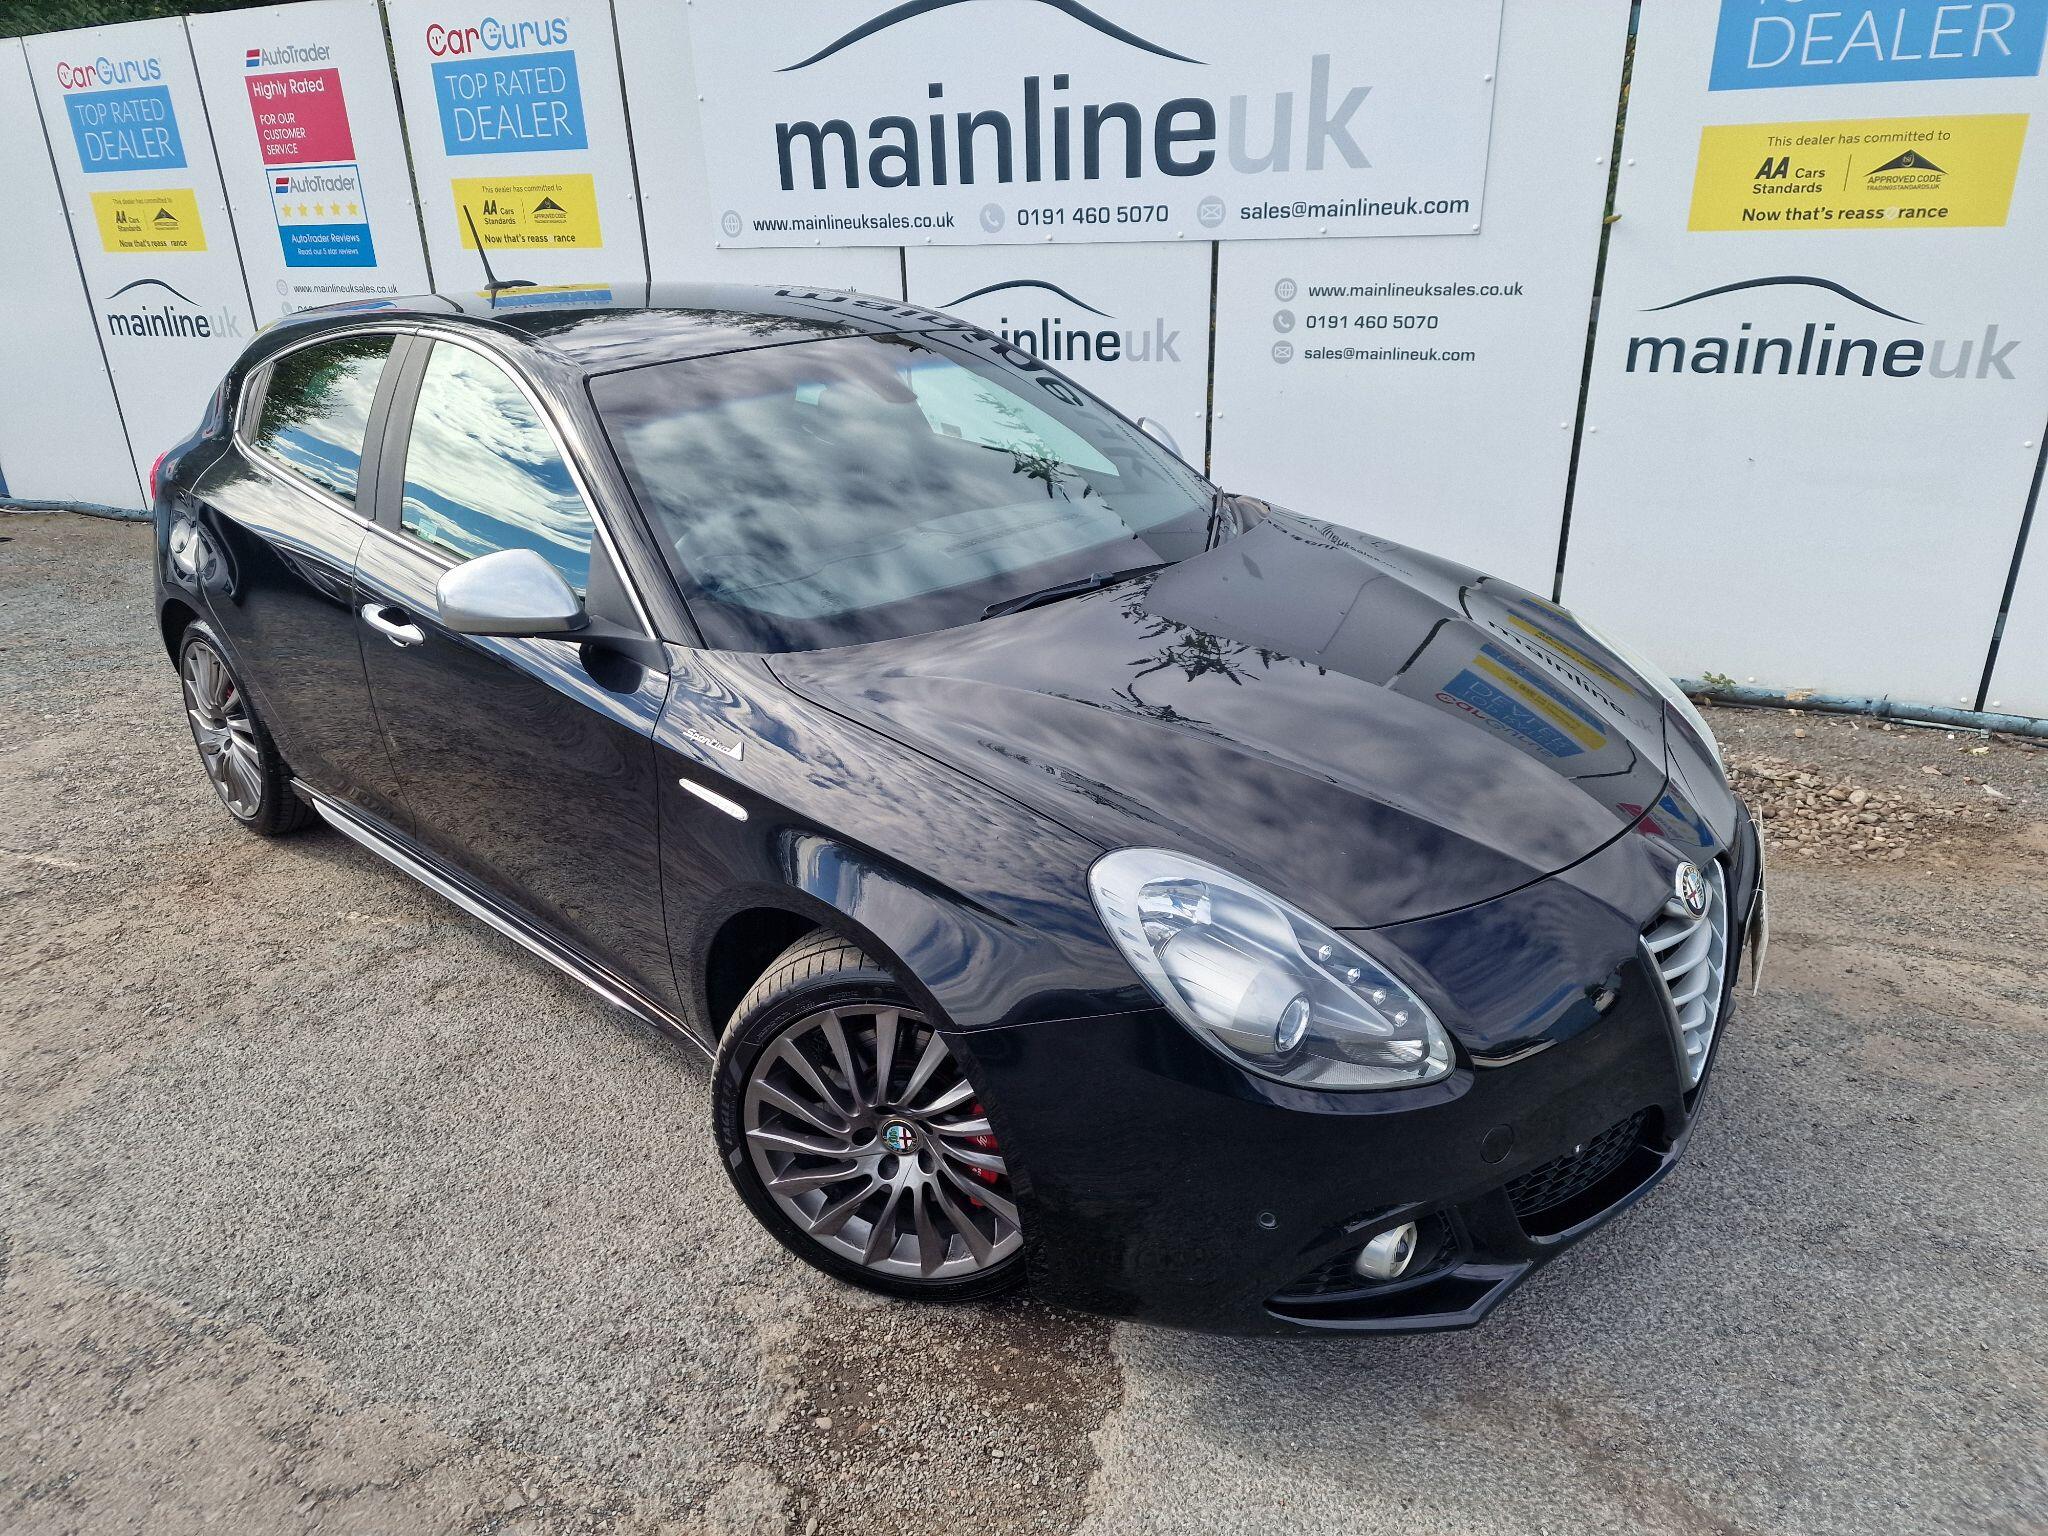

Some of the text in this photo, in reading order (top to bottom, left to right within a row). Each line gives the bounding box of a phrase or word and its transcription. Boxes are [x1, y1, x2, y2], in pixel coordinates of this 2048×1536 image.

[426, 17, 568, 57] CarGurus
[1747, 2, 2016, 69] DEALER
[261, 43, 330, 66] AutoTrader
[57, 56, 161, 89] CarGurus
[253, 77, 324, 99] Highly Rated
[445, 66, 566, 100] TOP RATED
[75, 99, 164, 127] TOP RATED
[260, 113, 295, 125] FOR OUR
[454, 101, 573, 142] DEALER
[263, 128, 306, 140] CUSTOMER
[1767, 130, 1951, 147] This dealer has committed to
[85, 128, 175, 160] DEALER
[267, 143, 299, 155] SERVICE
[1754, 156, 1826, 180] AA Cars
[290, 174, 355, 193] AutoTrader
[1868, 174, 1942, 184] APPROVED CODE
[482, 185, 494, 193] This
[524, 184, 555, 192] committed
[1752, 183, 1823, 195] Standards
[483, 200, 515, 215] AA Cars
[1017, 205, 1169, 226] 0191 460 5070
[1240, 197, 1470, 220] sales@mainlineuk.com
[1742, 208, 1780, 222] Now
[1785, 206, 1833, 221] that's
[116, 211, 127, 223] AA
[484, 218, 517, 226] Standards
[753, 211, 956, 232] www.mainlineuksales.co.uk
[119, 240, 133, 248] Now
[292, 233, 360, 243] AutoTrader Reviews
[484, 234, 502, 244] Now
[503, 233, 526, 243] that's
[293, 284, 399, 294] www.mainlineuksales.co.uk
[1308, 282, 1525, 298] www.mainlineuksales.co.uk
[1306, 315, 1439, 329] 0191 460 5070
[1304, 347, 1476, 362] sales@mainlineuk.com
